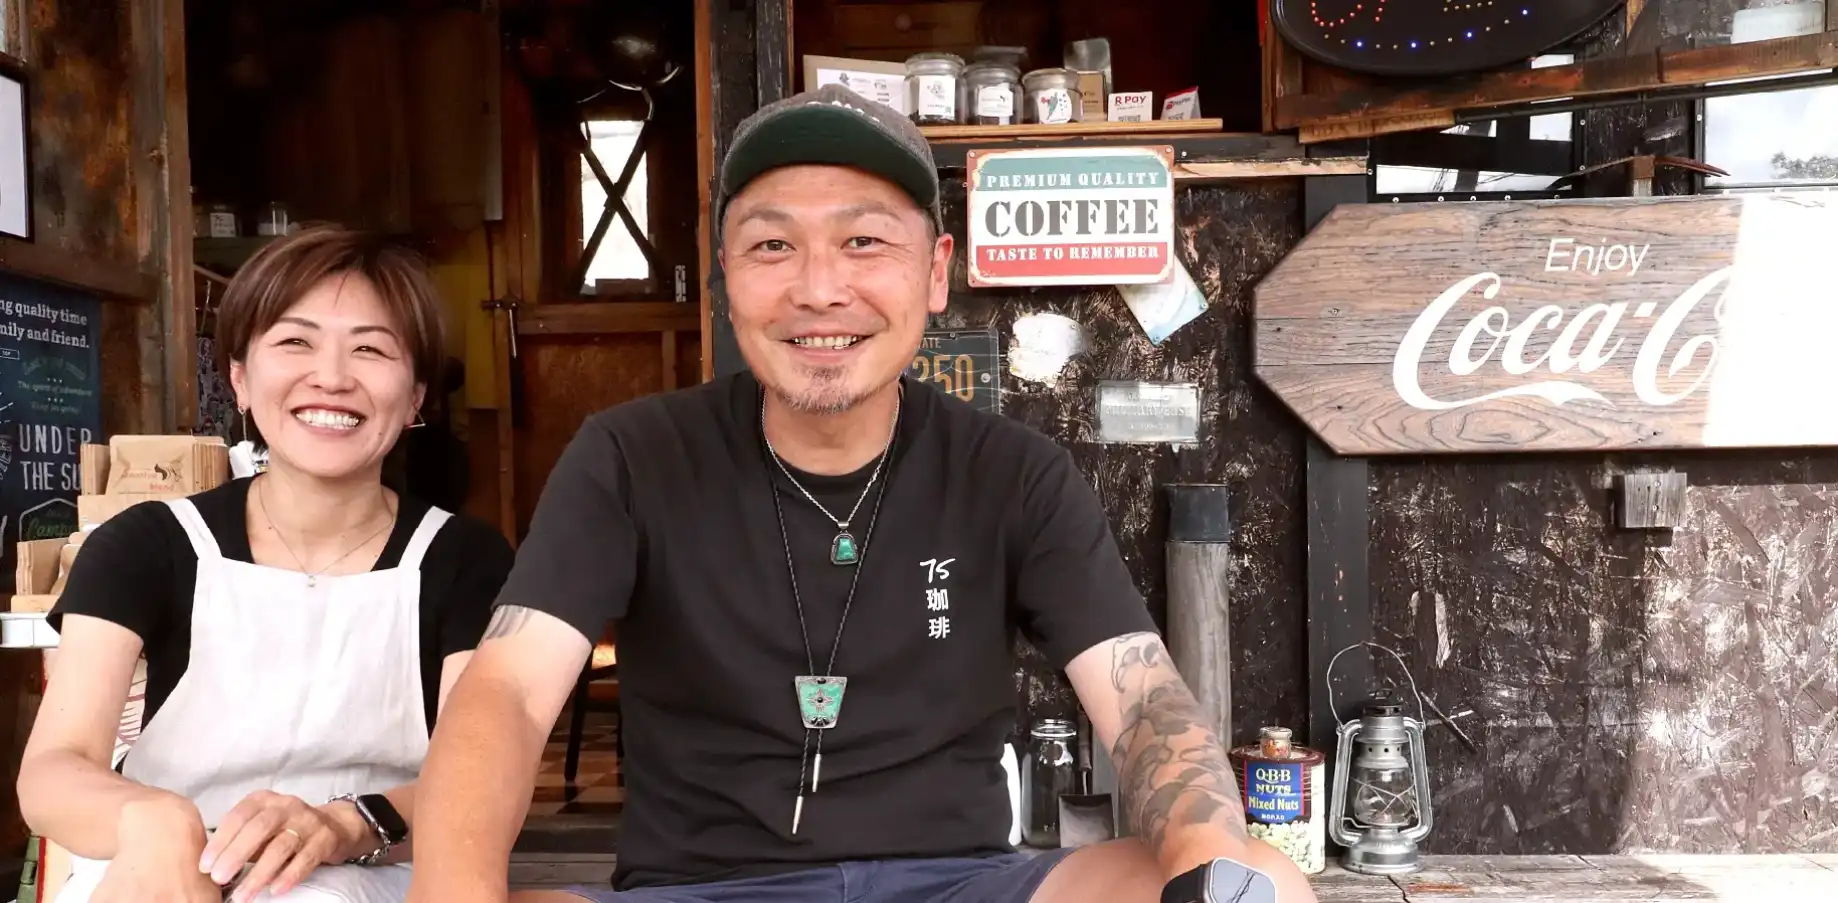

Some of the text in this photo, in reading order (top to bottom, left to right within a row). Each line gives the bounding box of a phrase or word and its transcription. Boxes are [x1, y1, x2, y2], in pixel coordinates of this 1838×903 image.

[986, 172, 1159, 188] PREMIUM QUALITY
[985, 199, 1159, 237] COFFEE
[986, 246, 1160, 261] TASTE TO REMEMBER
[1544, 238, 1650, 276] Enjoy
[15, 302, 58, 323] quality
[60, 308, 87, 325] time
[27, 328, 50, 342] and
[51, 329, 90, 348] friend.
[919, 338, 942, 348] ATE
[20, 461, 54, 491] THE
[1256, 783, 1291, 794] NUTS
[1248, 796, 1299, 811] Mixed Nuts
